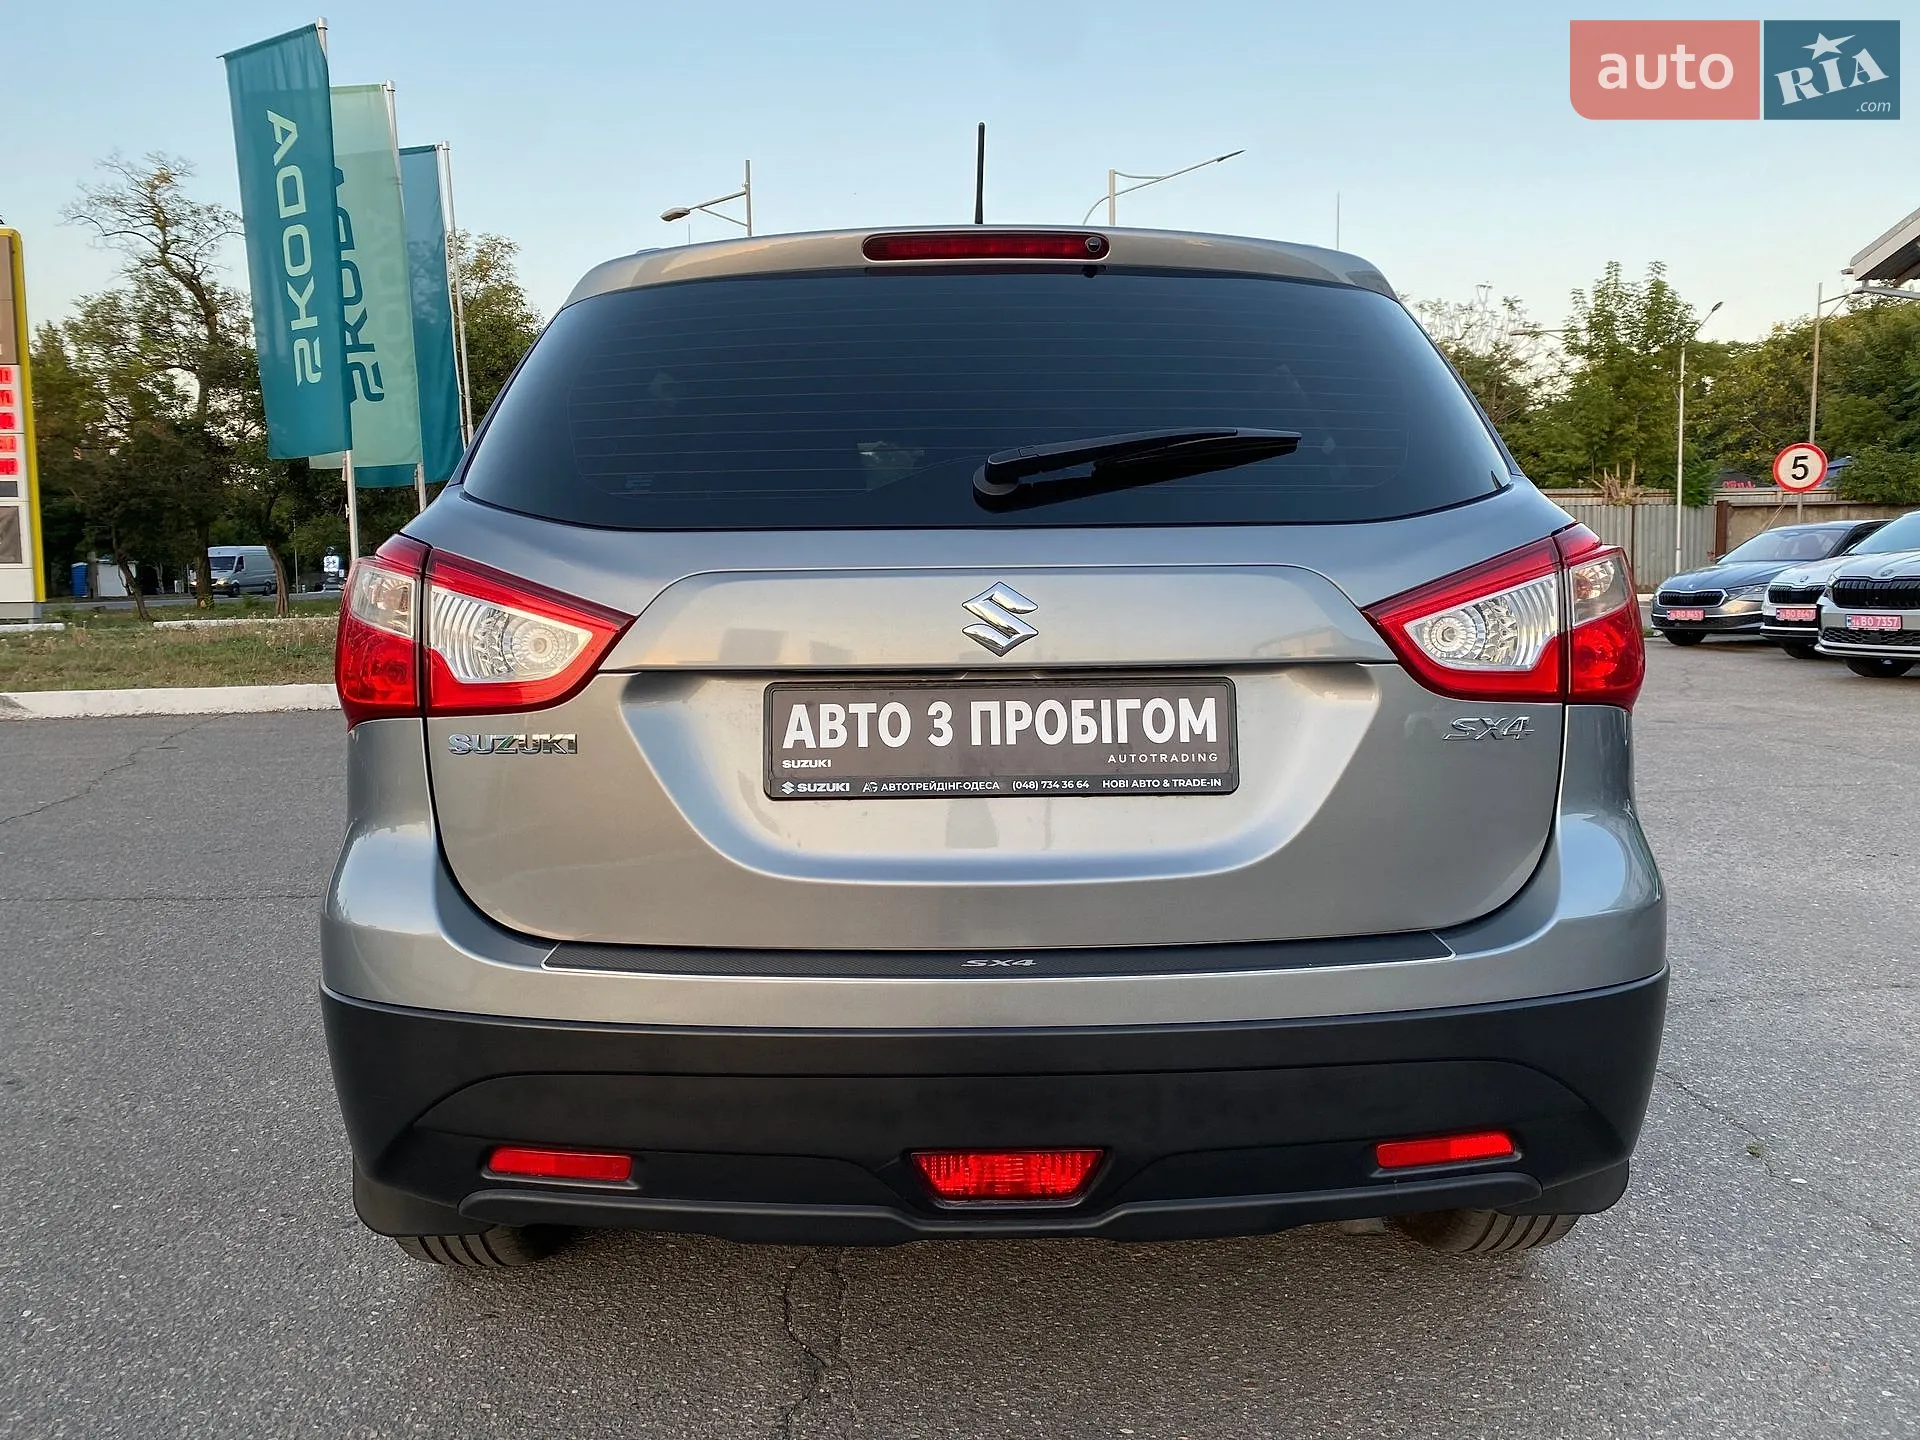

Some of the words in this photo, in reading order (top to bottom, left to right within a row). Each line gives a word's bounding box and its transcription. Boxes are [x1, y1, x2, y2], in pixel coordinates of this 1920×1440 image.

[1791, 455, 1809, 481] 5
[783, 701, 911, 748] АВТО
[970, 698, 1217, 746] ПРОБІГОМ
[1442, 716, 1535, 741] SX4
[448, 733, 558, 755] SUZUKI
[782, 759, 832, 769] SUZUKI
[1107, 752, 1218, 764] AUTOTRADING
[797, 782, 850, 793] SUZUKI
[881, 780, 1000, 792] АВТОТРЕЙДІНГ-ОДЕСА
[1012, 780, 1039, 791] (048)
[1041, 780, 1060, 789] 734
[1062, 780, 1075, 789] 36
[1076, 780, 1090, 789] 64
[1102, 779, 1129, 789] НОВІ
[1131, 779, 1160, 788] АВТО
[1172, 778, 1222, 788] TRADE-IN
[960, 959, 1037, 967] SX4
